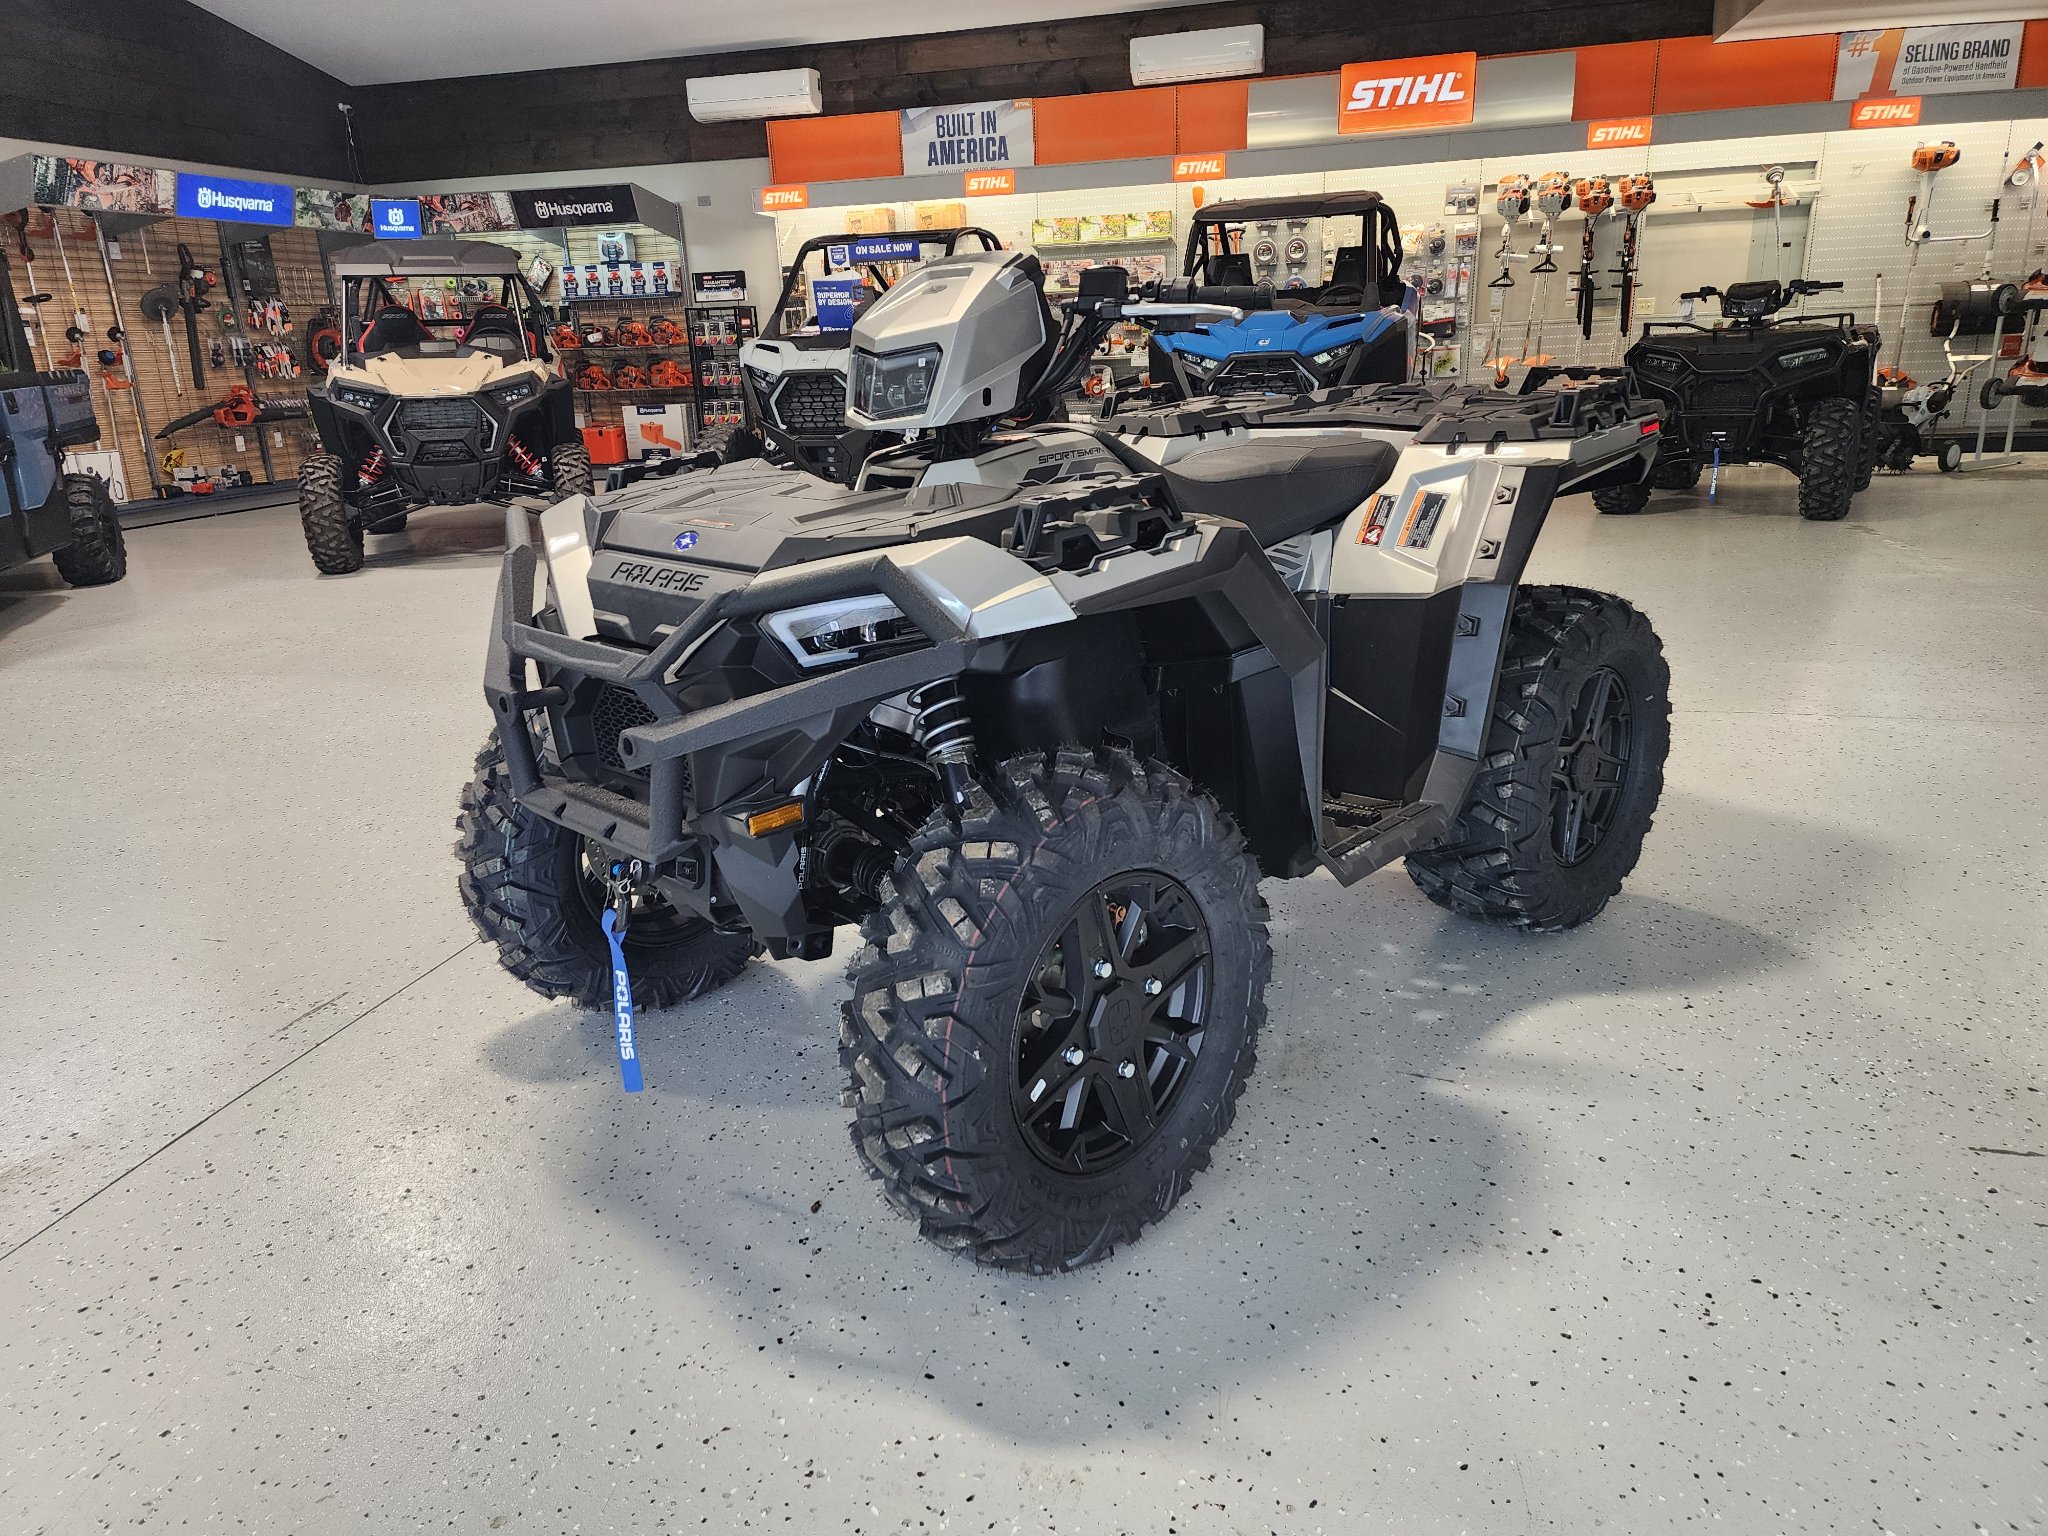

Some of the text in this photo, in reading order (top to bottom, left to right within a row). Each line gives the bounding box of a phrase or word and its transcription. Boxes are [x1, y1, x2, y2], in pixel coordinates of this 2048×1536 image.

[1905, 38, 2011, 63] SELLING BRAND
[1903, 60, 2008, 75] of Gasoline-Powered Handheld
[1944, 73, 1975, 82] Equipment
[1346, 71, 1465, 111] STIHL
[1857, 105, 1915, 121] STIHL
[936, 110, 997, 138] BUILT IN
[1592, 125, 1645, 143] STIHL
[927, 135, 1010, 166] AMERICA
[1176, 160, 1222, 175] STIHL
[968, 176, 1010, 191] STIHL
[211, 191, 273, 212] Husqvarna
[764, 191, 803, 205] STIHL
[547, 201, 614, 217] Husqvarna
[380, 224, 415, 232] Husqvarna
[856, 245, 868, 255] ON
[869, 244, 891, 254] SALE
[893, 242, 913, 252] NOW
[816, 291, 850, 299] SUPERIOR
[1038, 447, 1105, 464] SPORTSMAN
[610, 561, 710, 592] POLARIS
[797, 846, 807, 890] POLARIS
[615, 970, 635, 1061] POLARIS
